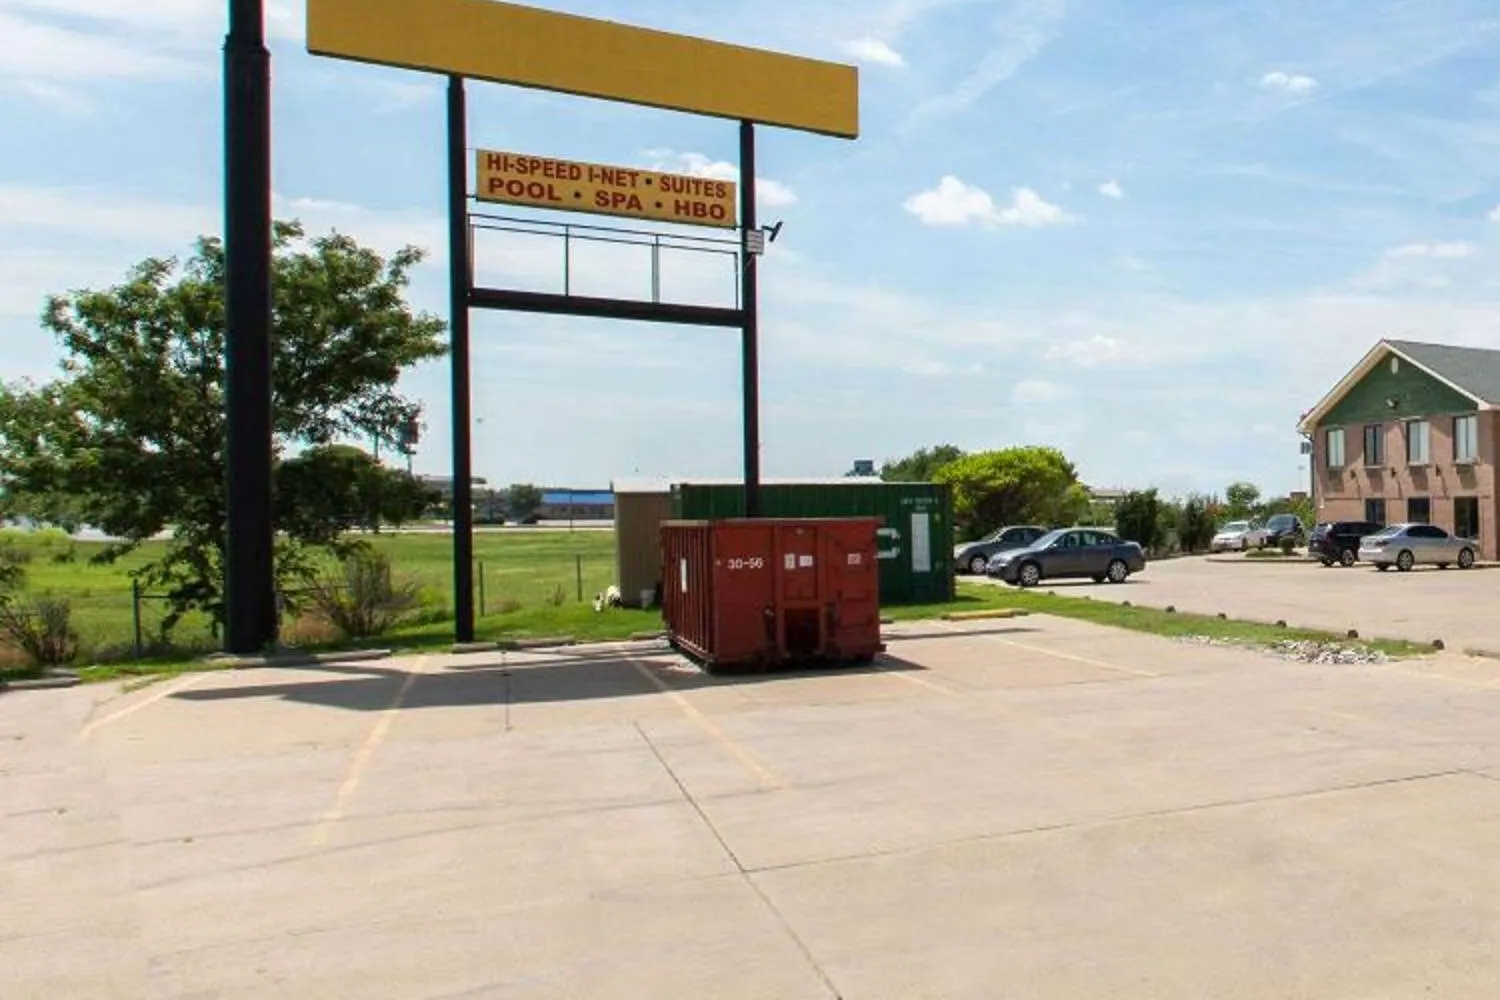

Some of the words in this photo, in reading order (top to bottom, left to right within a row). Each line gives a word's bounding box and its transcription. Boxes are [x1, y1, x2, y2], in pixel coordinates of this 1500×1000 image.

[487, 153, 581, 181] HI-SPEED
[588, 165, 640, 189] I-NET
[660, 174, 727, 199] SUITES
[488, 177, 563, 201] POOL
[595, 189, 643, 212] SPA
[674, 199, 726, 221] HBO
